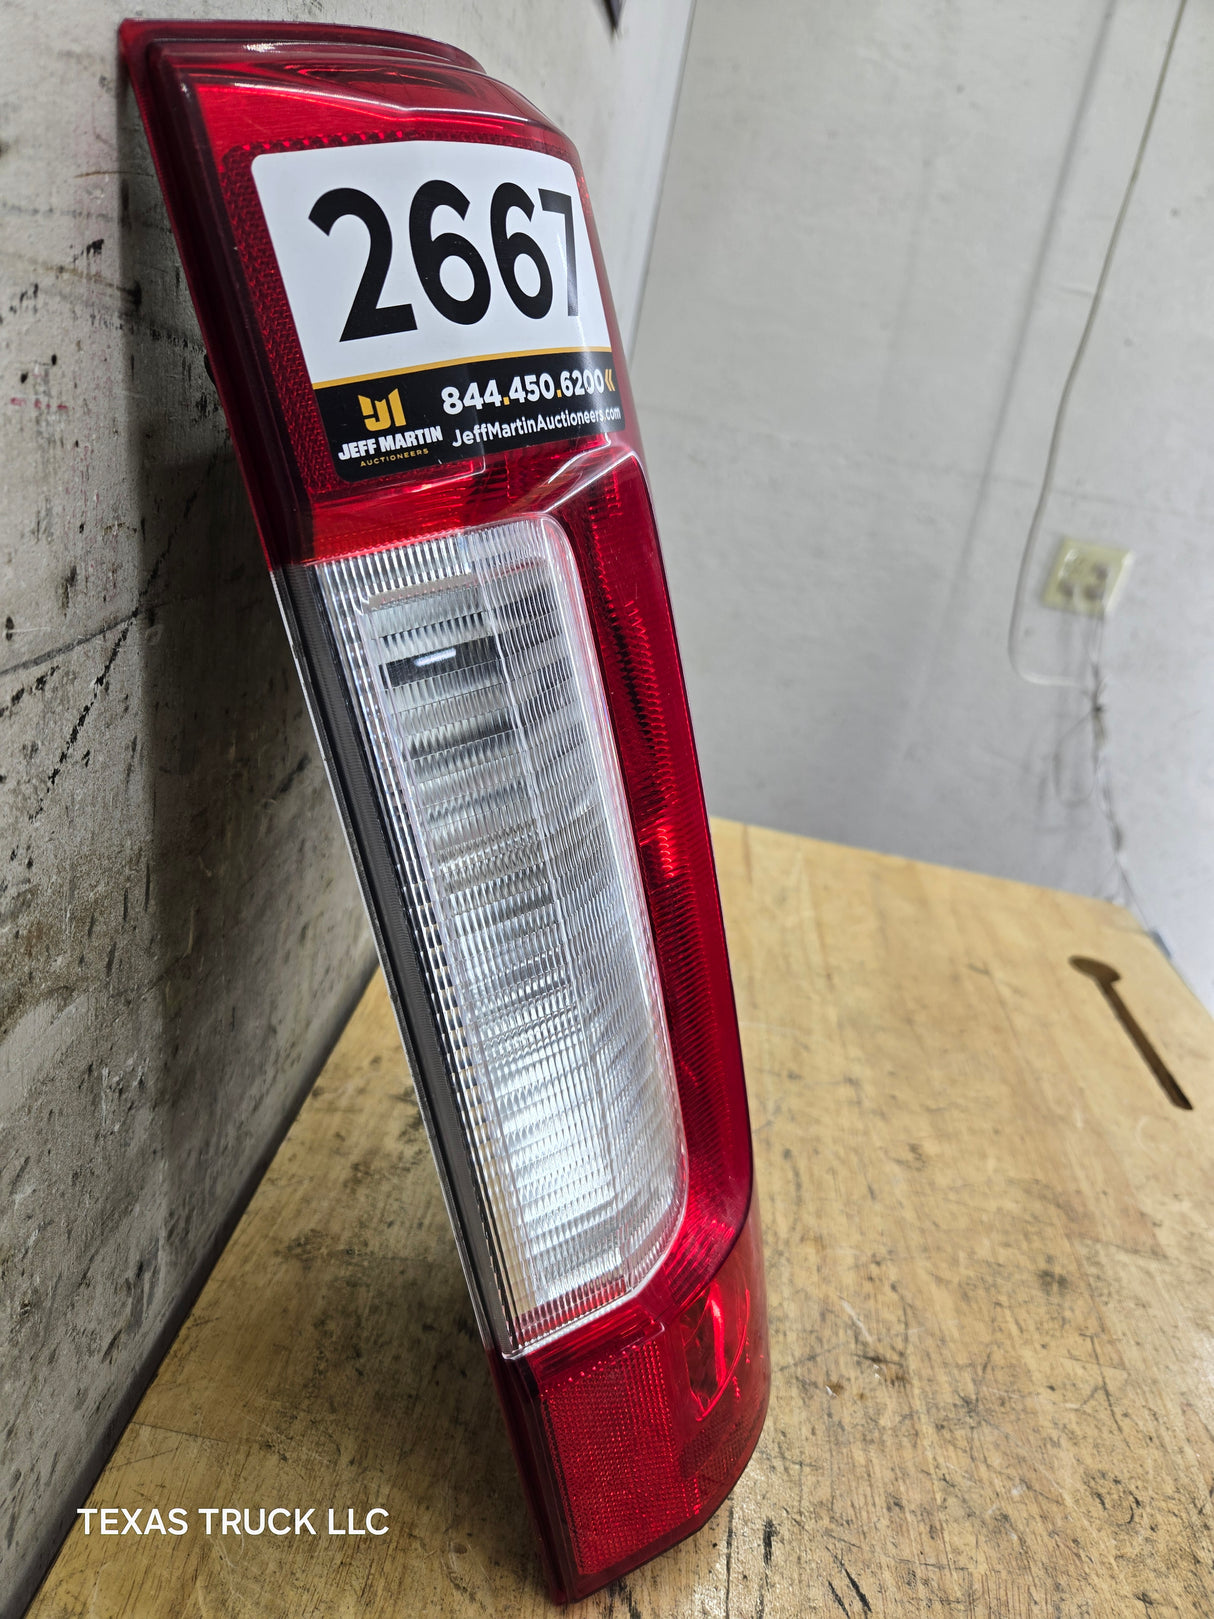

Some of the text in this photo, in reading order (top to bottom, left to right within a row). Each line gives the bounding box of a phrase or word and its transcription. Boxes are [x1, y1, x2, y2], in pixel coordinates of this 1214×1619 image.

[308, 179, 579, 342] 2667
[441, 368, 605, 415] 844.450.6200
[338, 425, 444, 461] JEFF MARTIN
[452, 406, 622, 448] JeffMartinAuctioneers.com
[360, 447, 429, 467] AUCTIONEERS
